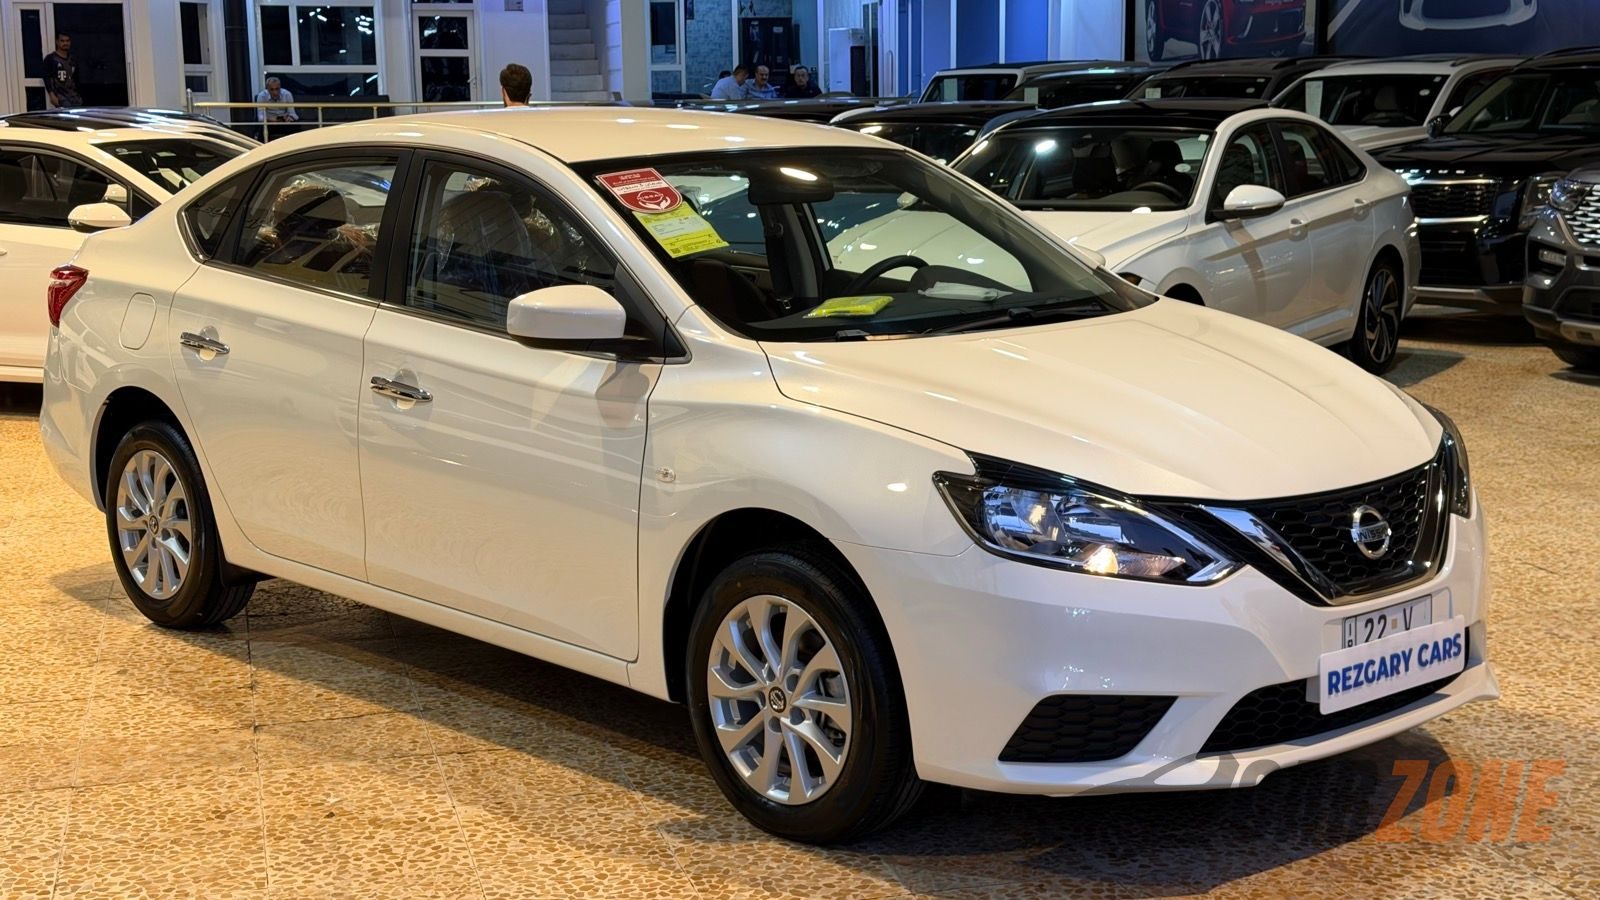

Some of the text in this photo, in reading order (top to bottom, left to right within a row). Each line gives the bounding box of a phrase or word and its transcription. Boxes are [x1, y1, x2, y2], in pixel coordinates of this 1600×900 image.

[1364, 606, 1413, 643] 22 V
[1327, 633, 1462, 696] REZGARY CARS
